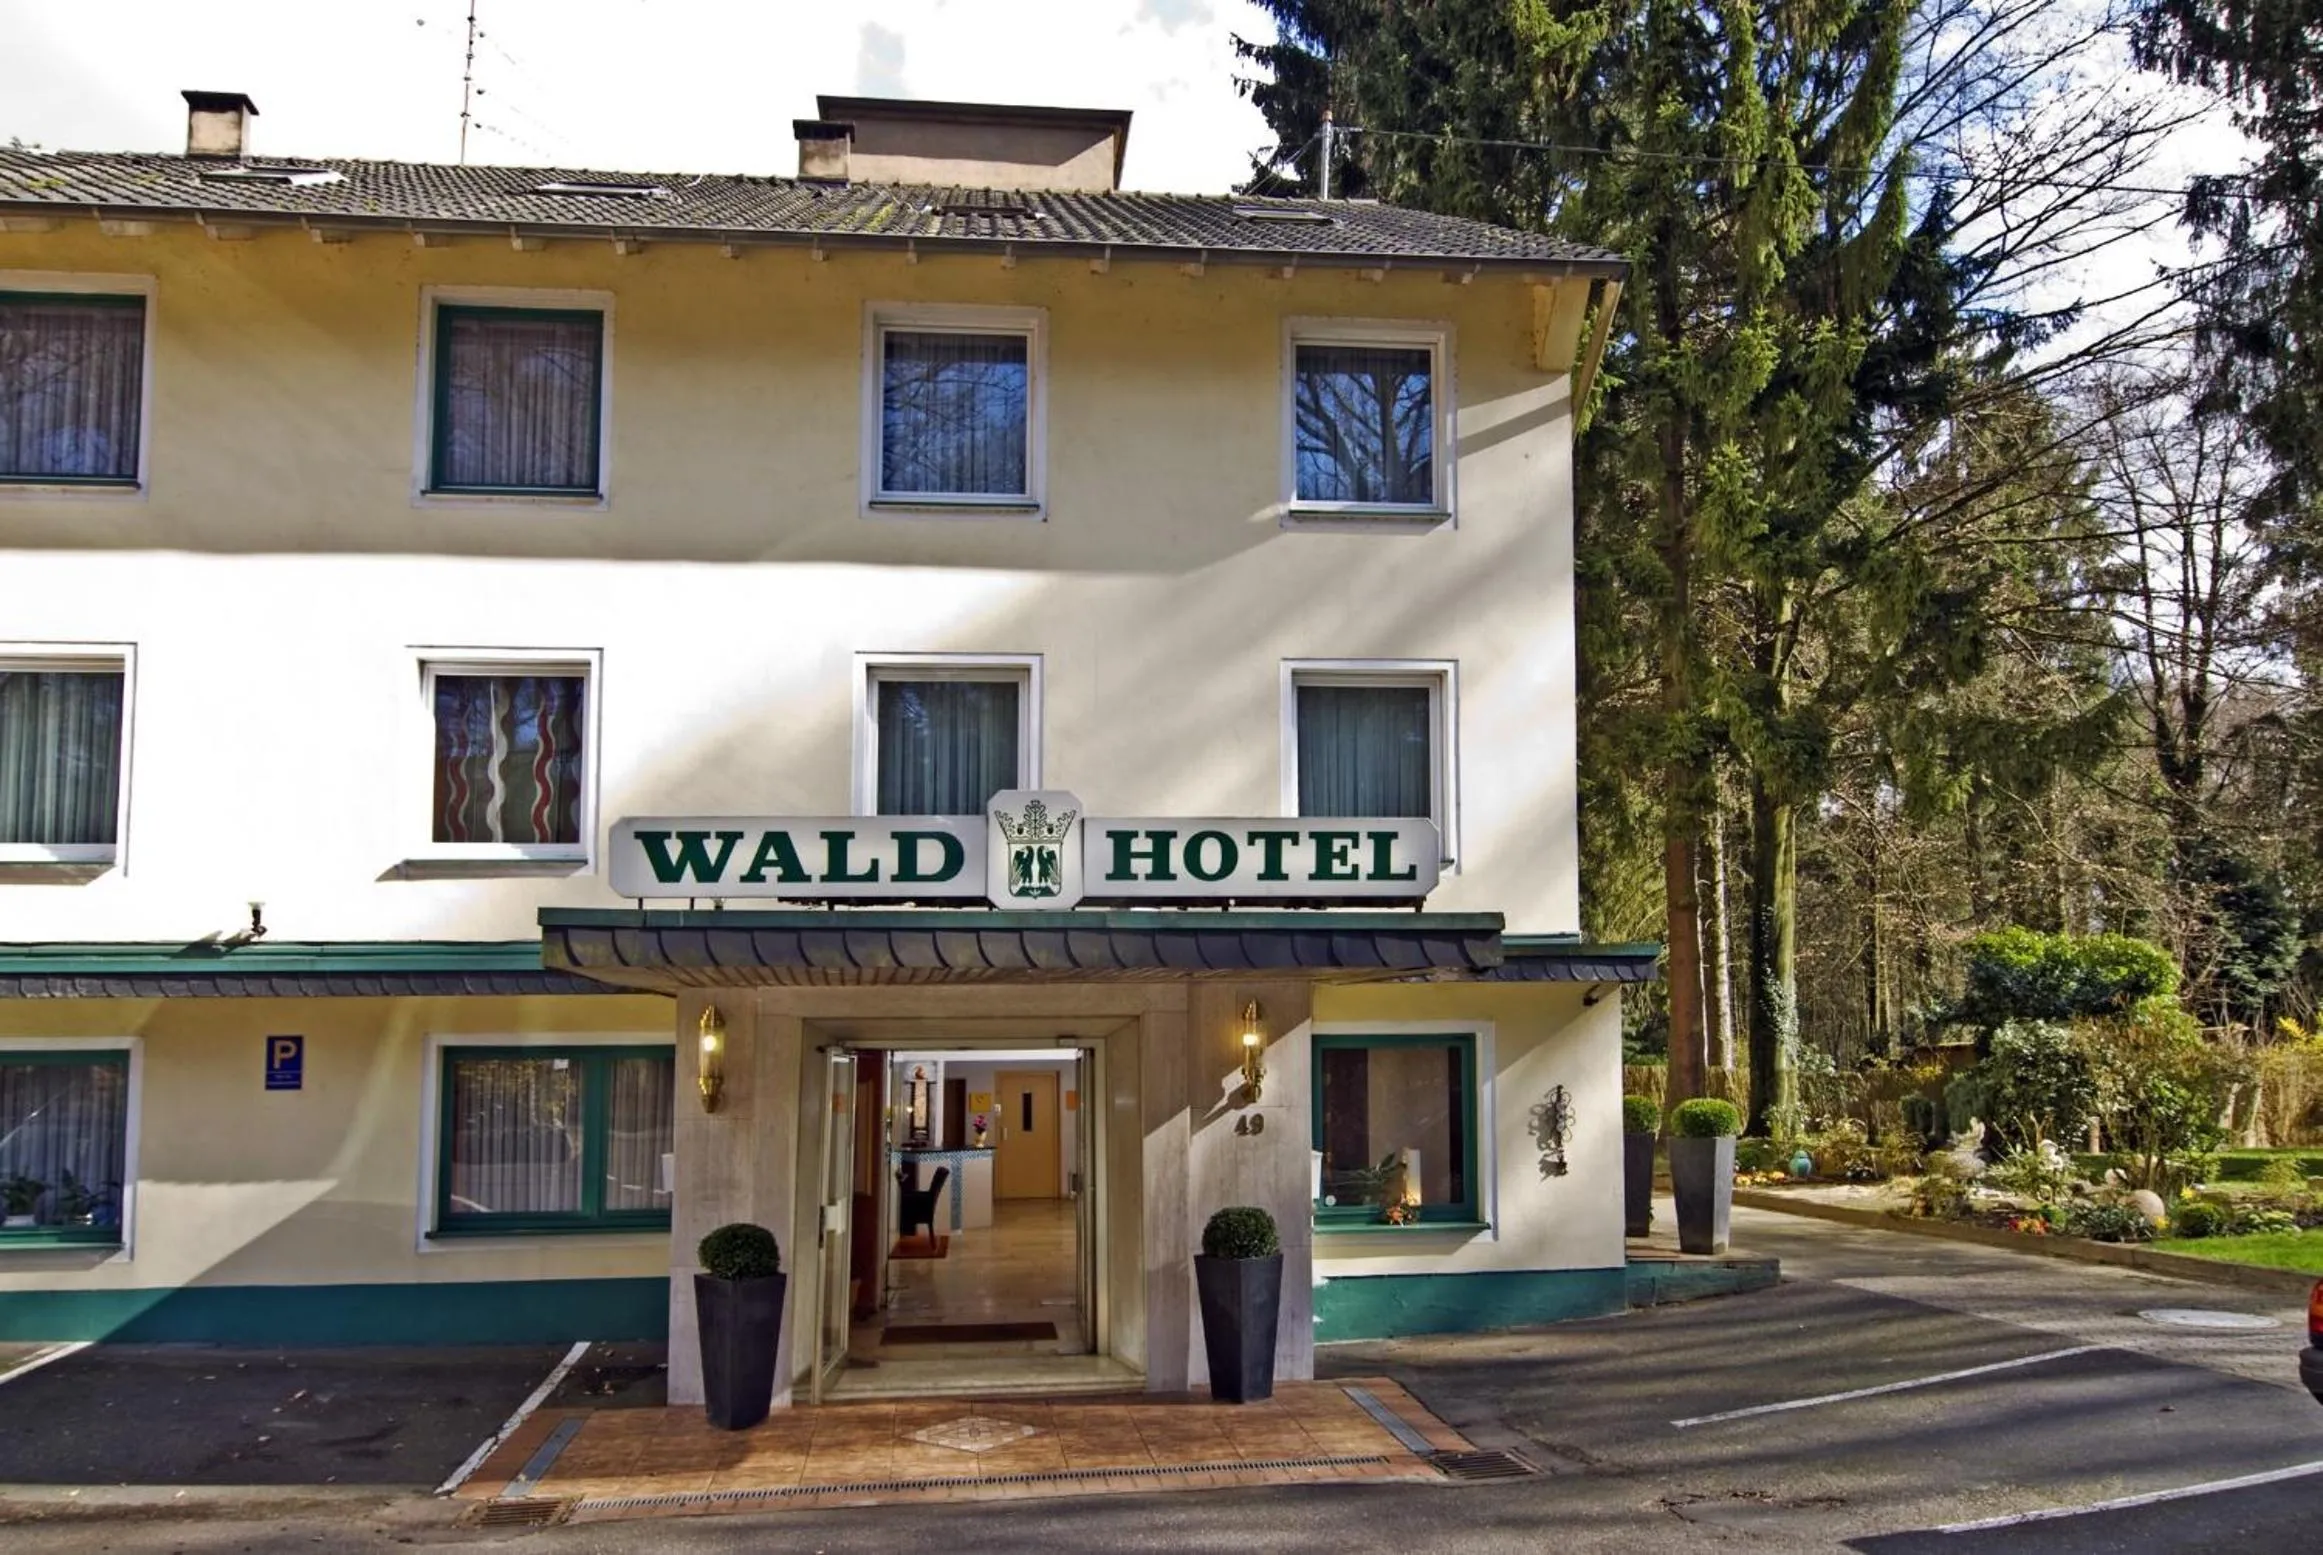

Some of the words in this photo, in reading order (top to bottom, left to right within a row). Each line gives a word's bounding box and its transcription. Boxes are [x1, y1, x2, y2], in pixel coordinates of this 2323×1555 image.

[633, 830, 965, 884] WALD
[1105, 829, 1417, 882] HOTEL
[273, 1040, 297, 1069] P
[1234, 1113, 1264, 1136] 49
